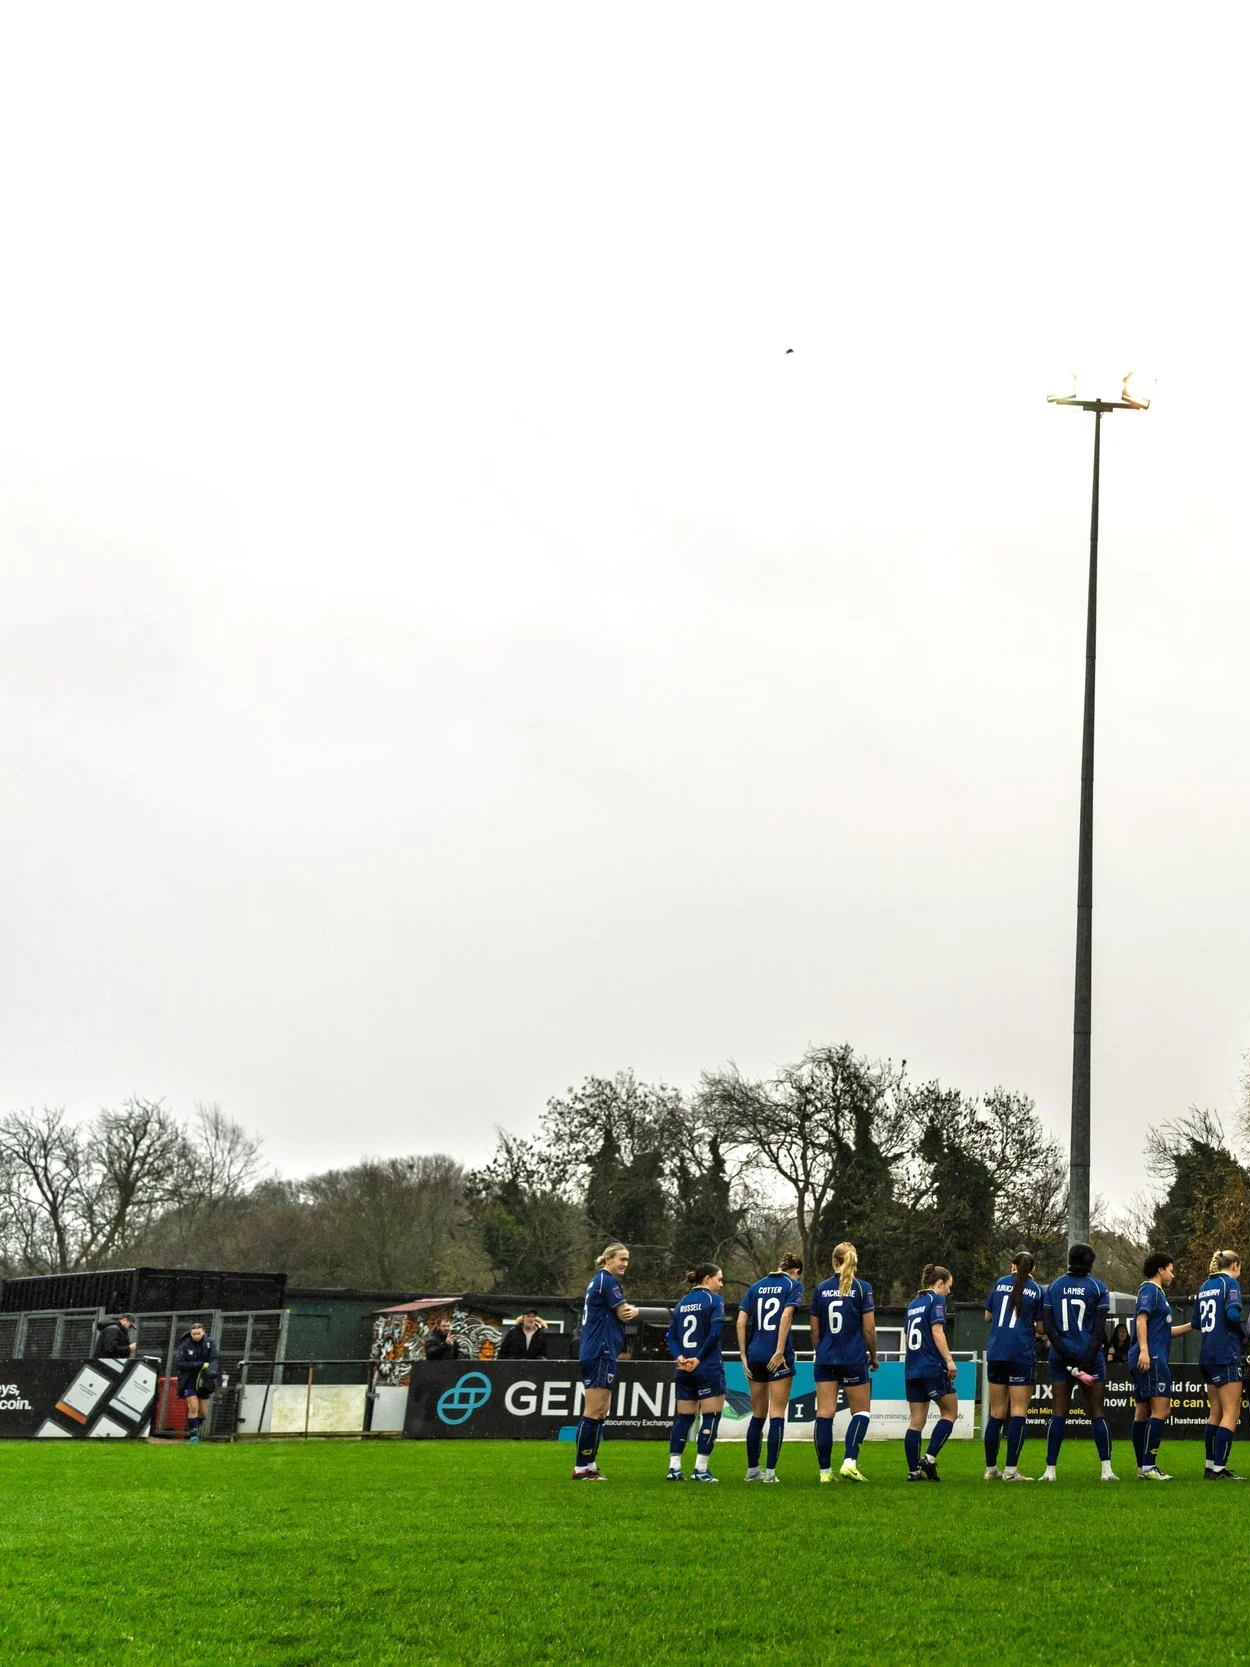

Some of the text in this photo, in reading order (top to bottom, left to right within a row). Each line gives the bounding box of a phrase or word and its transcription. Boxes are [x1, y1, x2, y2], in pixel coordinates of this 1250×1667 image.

[758, 1286, 783, 1295] COTTER
[821, 1289, 856, 1298] MACKEIE
[1063, 1287, 1086, 1296] LAMBE
[680, 1303, 702, 1313] RUSSELL
[757, 1297, 781, 1331] 12
[828, 1300, 844, 1334] 6
[1061, 1298, 1086, 1331] 17
[1200, 1299, 1217, 1332] 23
[682, 1315, 698, 1348] 2
[1185, 1381, 1202, 1392] for
[0, 1396, 32, 1410] coin.
[1183, 1399, 1203, 1408] can
[1069, 1408, 1086, 1416] ools,
[642, 1419, 674, 1428] Exchange
